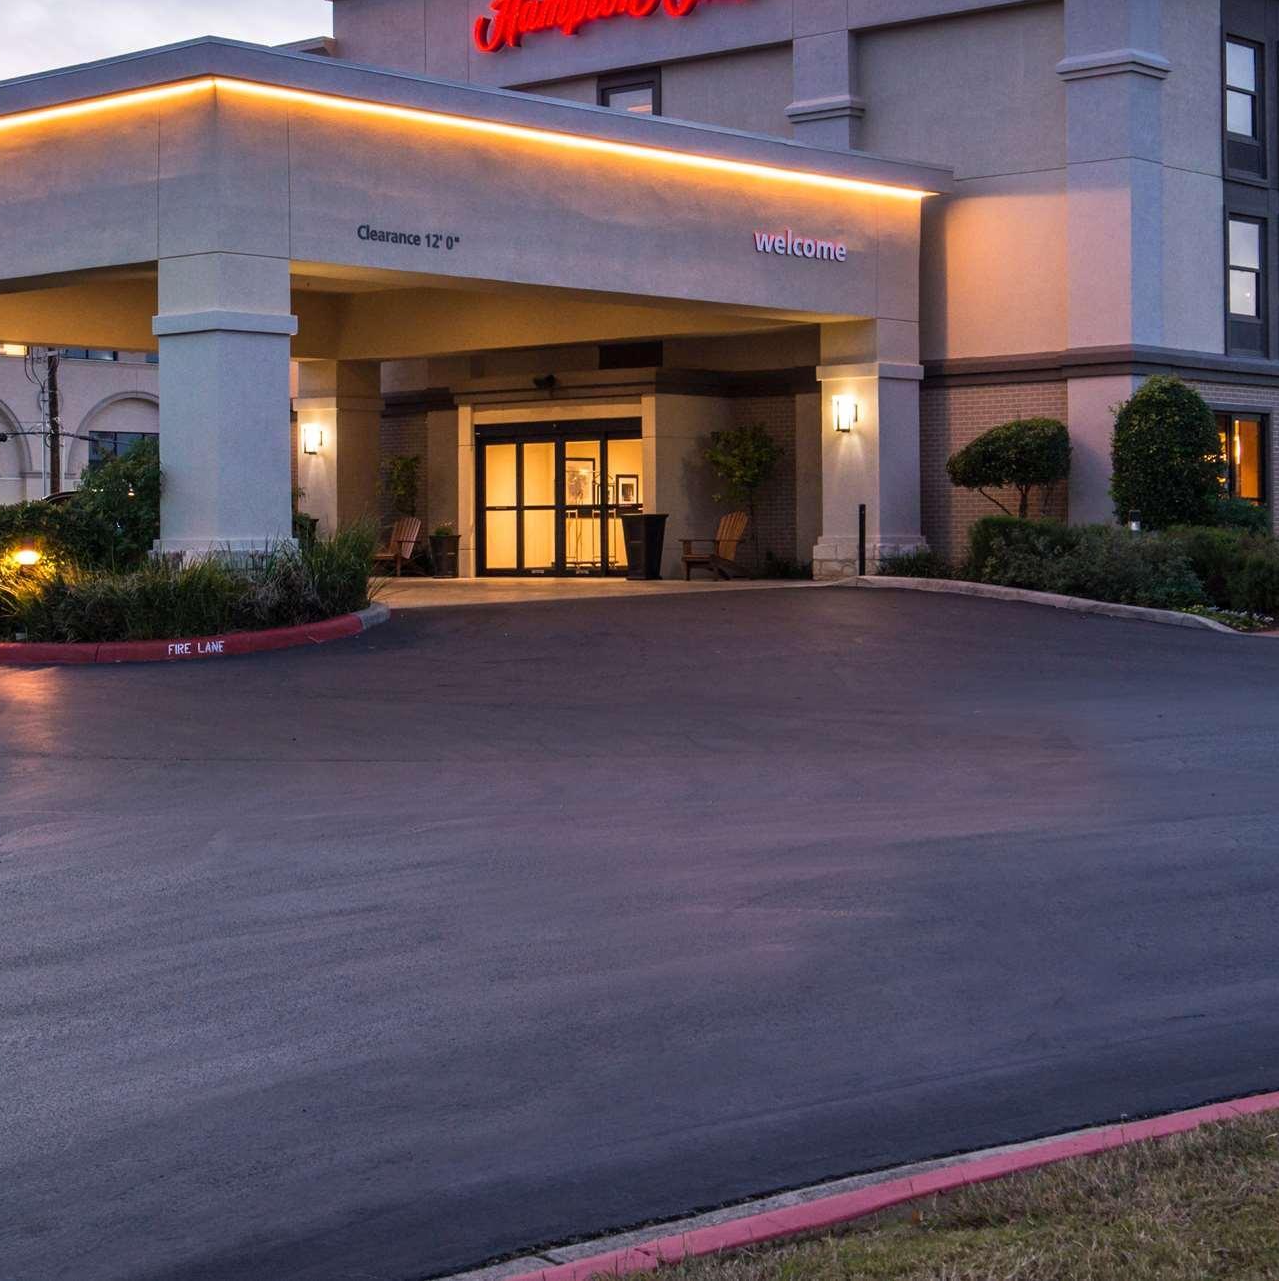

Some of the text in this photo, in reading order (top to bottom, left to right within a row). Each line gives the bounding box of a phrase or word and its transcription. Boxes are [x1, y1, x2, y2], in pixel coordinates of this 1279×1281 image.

[357, 224, 421, 246] Clearance
[424, 233, 443, 249] 12'
[753, 229, 847, 262] welcome
[168, 640, 225, 655] FIRE LANE
